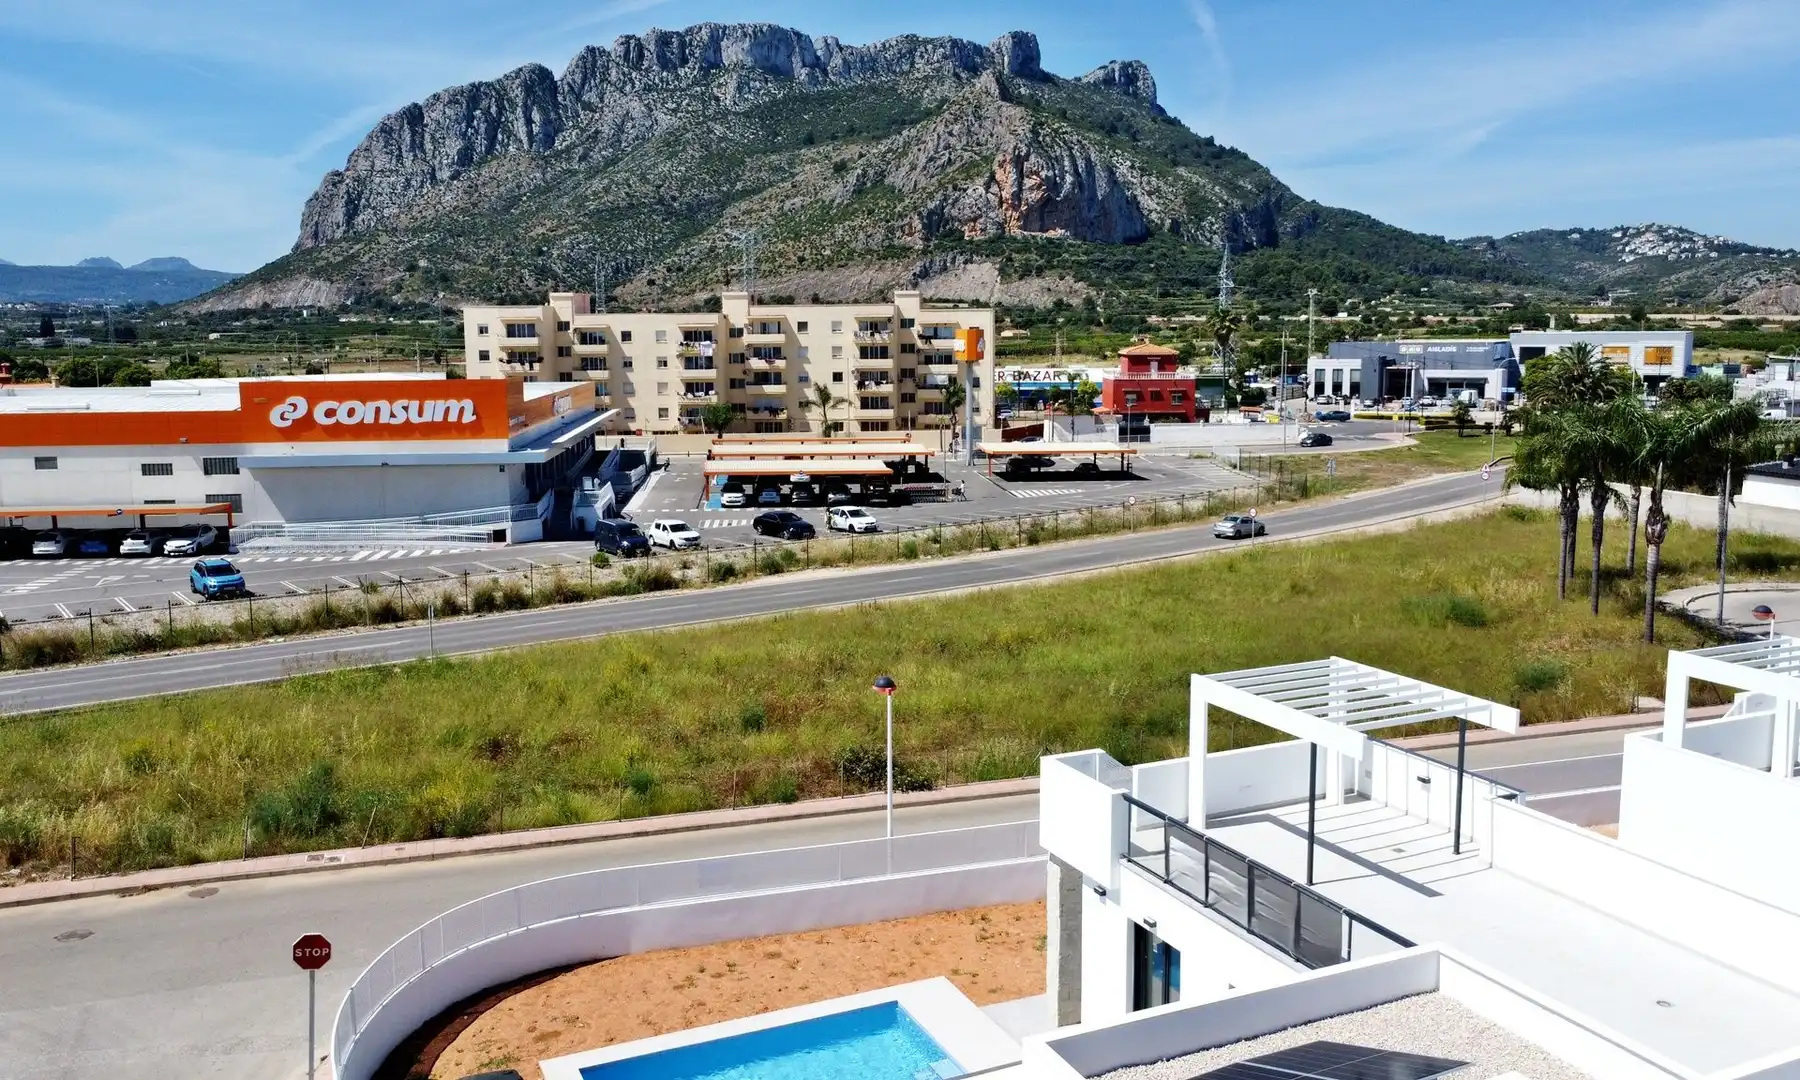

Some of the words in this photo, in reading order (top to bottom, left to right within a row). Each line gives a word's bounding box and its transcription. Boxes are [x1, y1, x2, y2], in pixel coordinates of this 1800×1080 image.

[1012, 370, 1061, 382] BAZAR
[313, 399, 477, 426] consum
[295, 947, 330, 957] STOP
